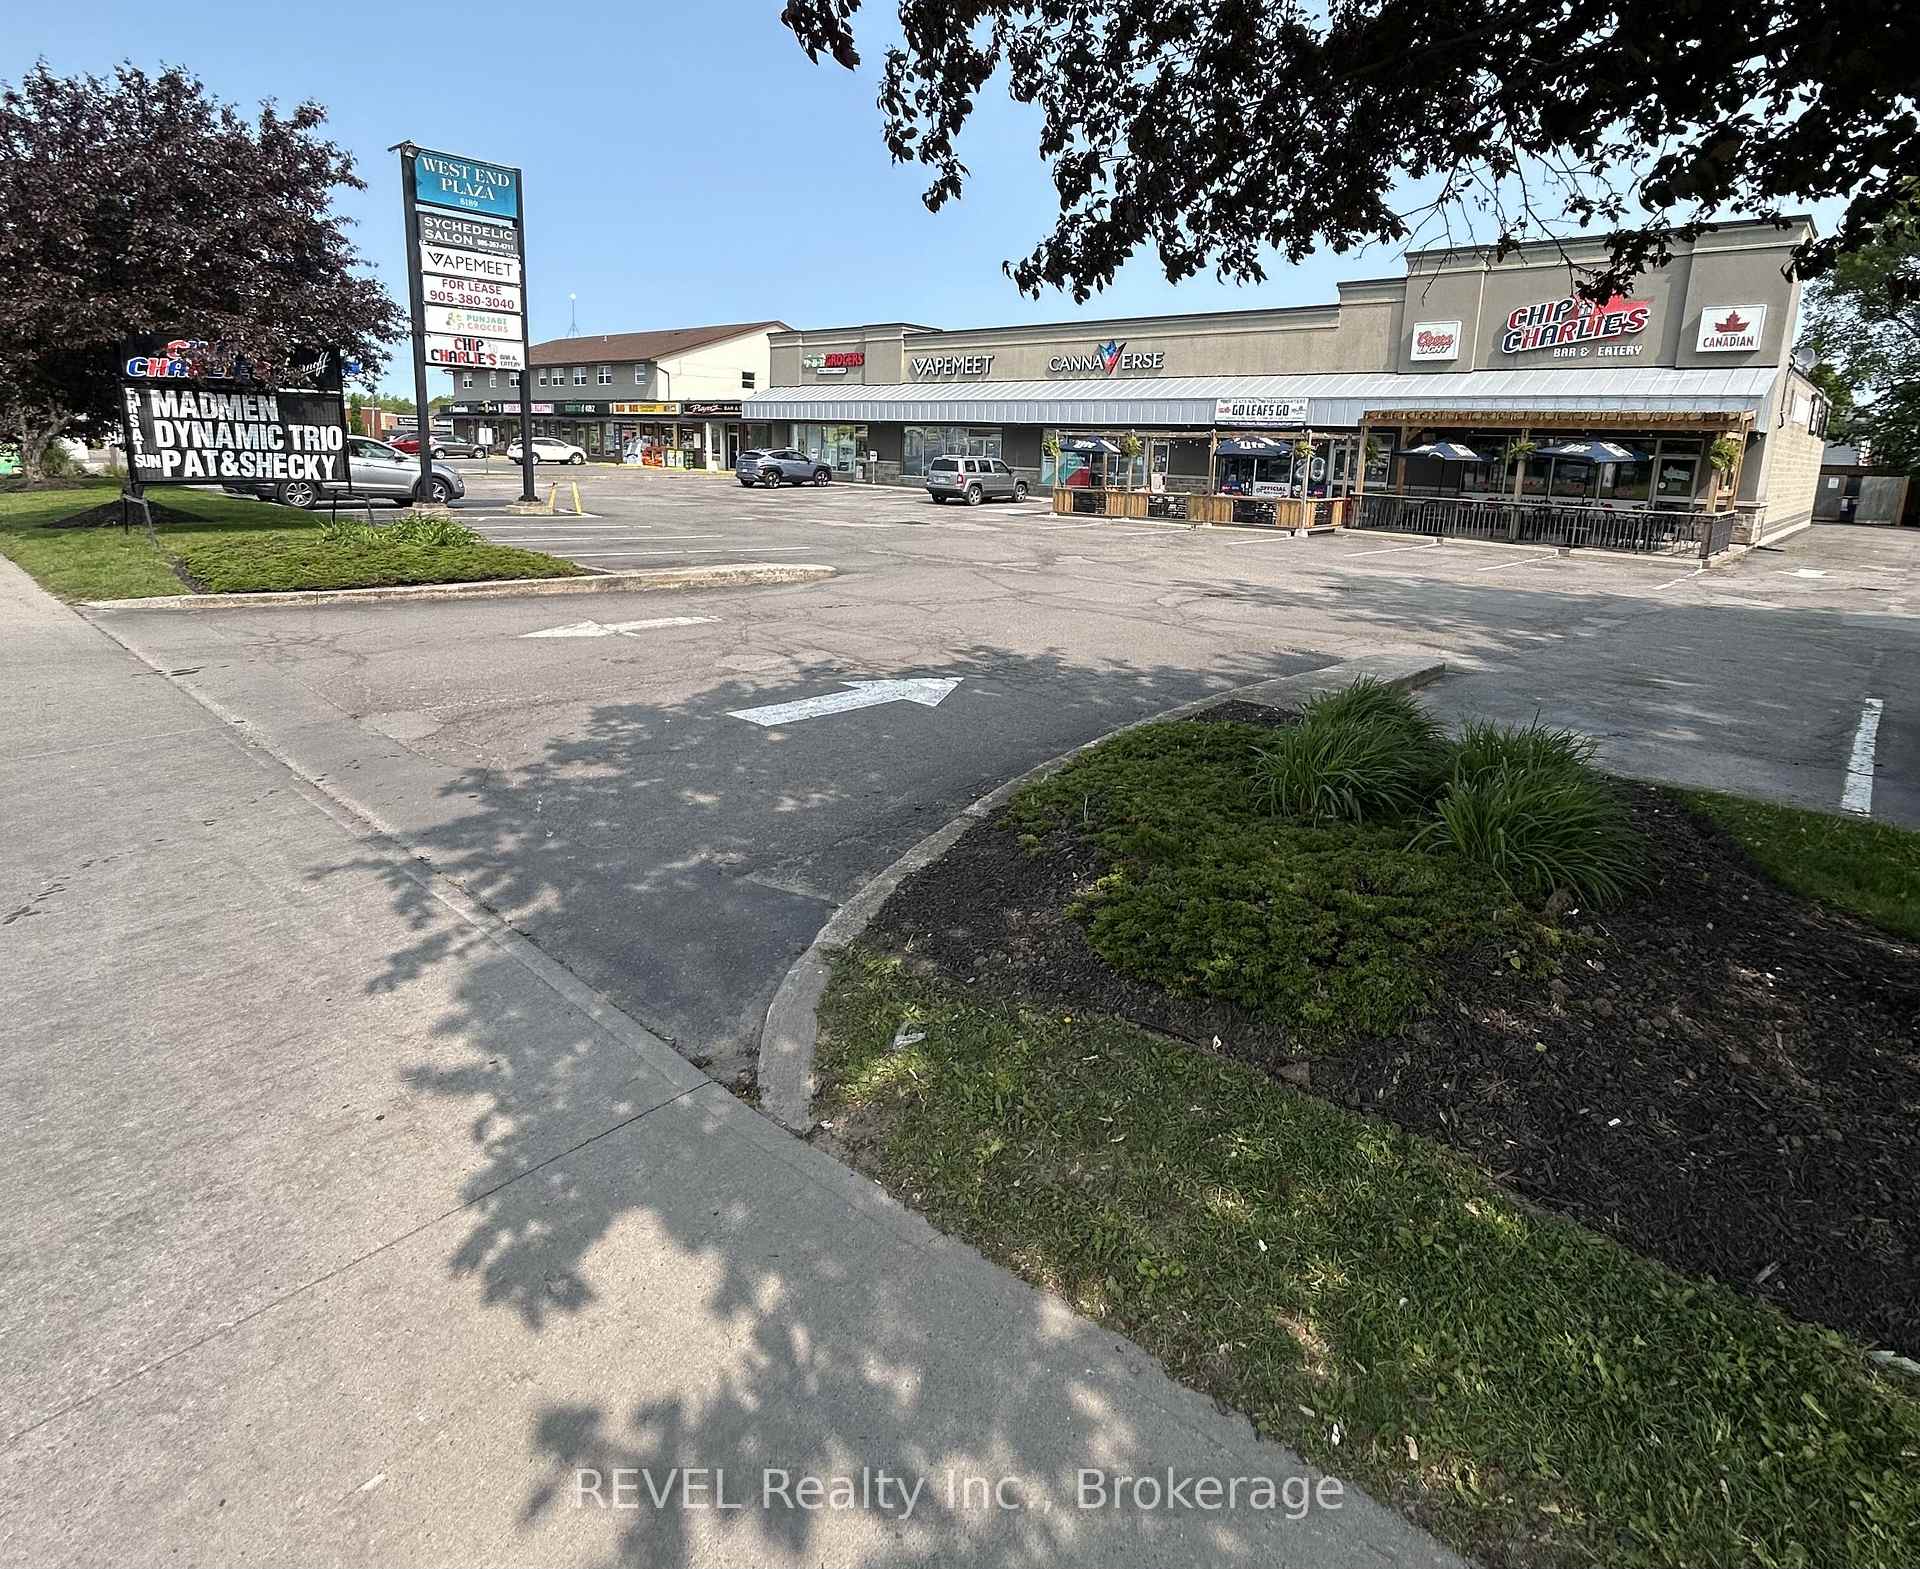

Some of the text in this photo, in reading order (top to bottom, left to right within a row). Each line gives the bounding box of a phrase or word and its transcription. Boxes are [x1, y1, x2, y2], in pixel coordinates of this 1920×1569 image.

[421, 157, 510, 187] WEST END
[441, 178, 495, 200] PLAZA
[424, 216, 513, 240] SYCHEDELIC
[424, 229, 473, 245] SALON
[427, 251, 513, 276] VAPEMEET
[441, 278, 502, 295] FOR LEASE
[430, 290, 514, 310] 905-380-3040
[466, 314, 508, 325] PUNJABI
[1507, 298, 1576, 330] CHIP
[467, 322, 509, 333] GROCERS
[1502, 307, 1651, 354] CHARLIE'S
[454, 337, 484, 351] CHIP
[1416, 345, 1451, 354] LIGHT
[1553, 344, 1643, 358] BAR & EATERY
[1703, 336, 1755, 348] CANADIAN
[430, 349, 497, 366] CHARLIE'S
[825, 352, 865, 368] GROCERS
[911, 354, 995, 376] VAPEMEET
[150, 389, 280, 422] MADMEN
[1232, 404, 1289, 416] GO LEAFS GO
[154, 420, 343, 451] DYNAMIC TRIO
[134, 450, 336, 481] SUN PAT&SHECKY
